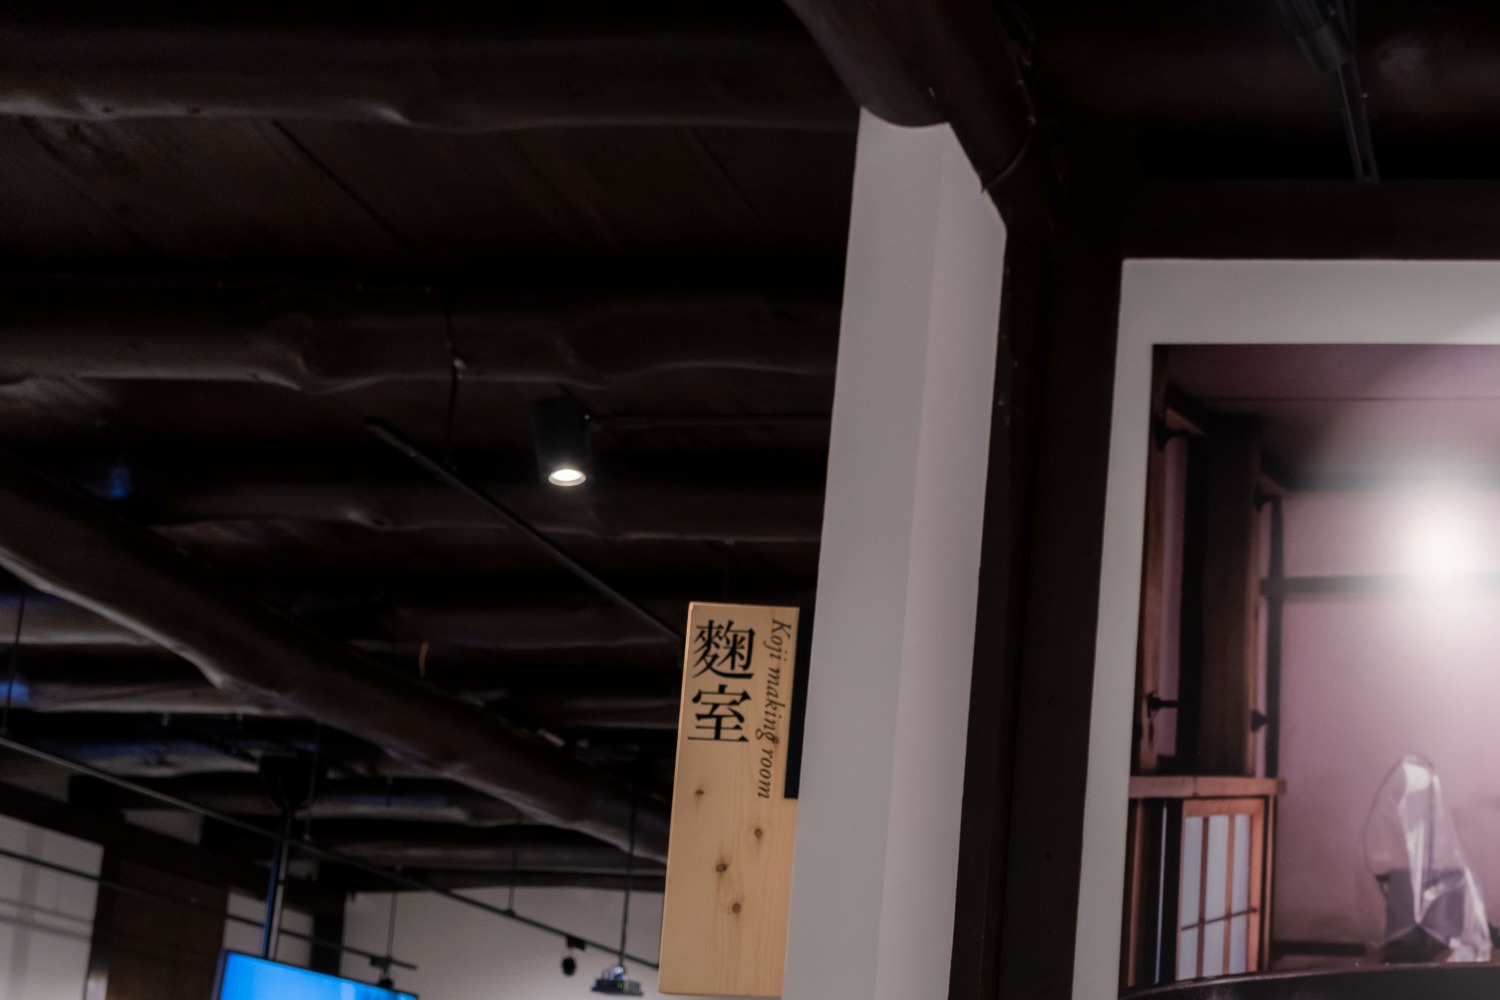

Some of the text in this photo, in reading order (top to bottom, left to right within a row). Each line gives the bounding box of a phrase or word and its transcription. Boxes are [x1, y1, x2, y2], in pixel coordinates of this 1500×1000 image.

[755, 618, 792, 799] Koji making room
